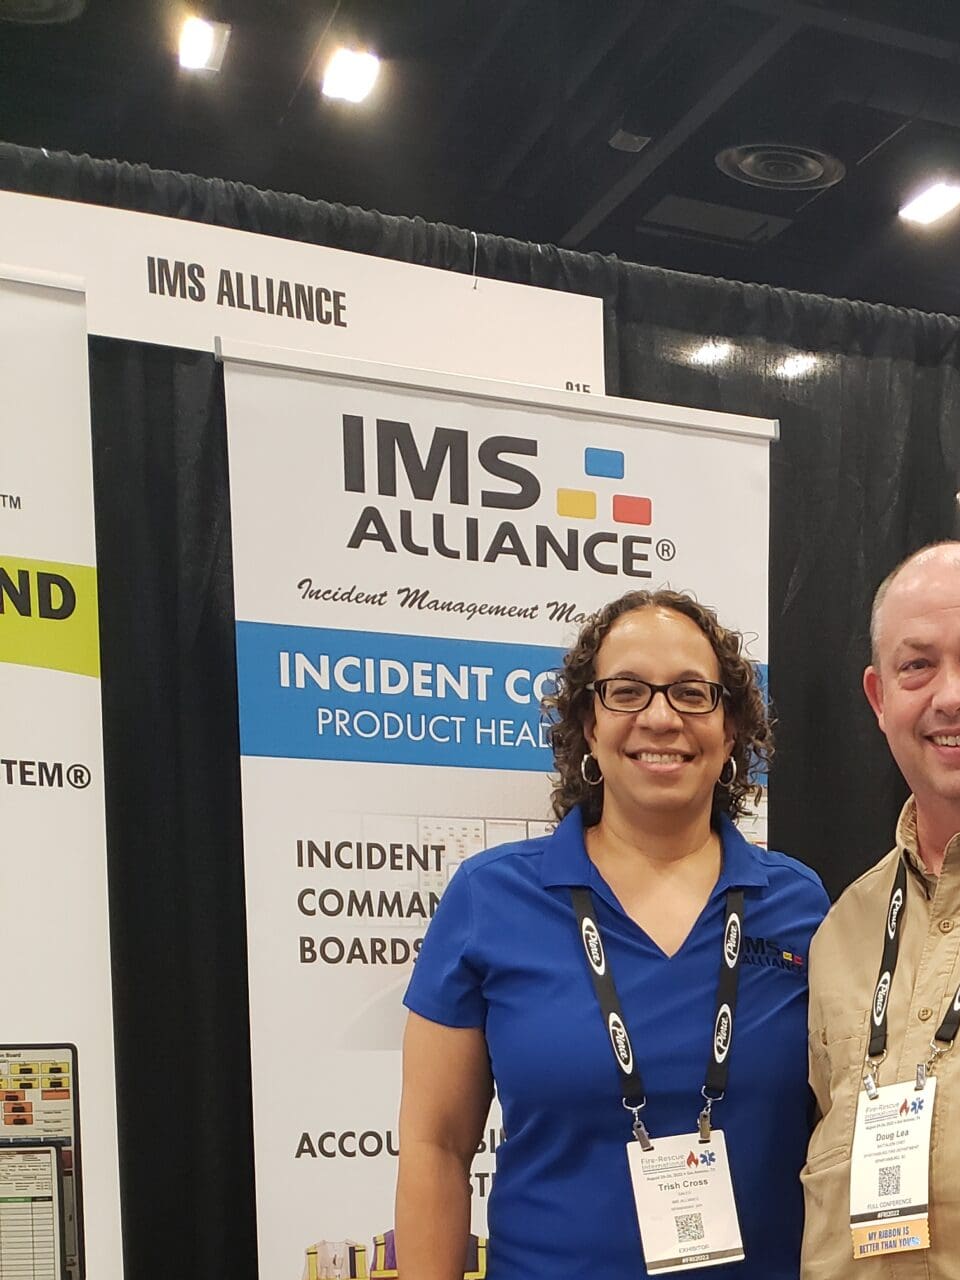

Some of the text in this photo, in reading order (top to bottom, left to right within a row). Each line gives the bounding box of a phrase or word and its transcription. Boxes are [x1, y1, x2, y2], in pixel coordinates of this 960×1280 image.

[146, 255, 347, 328] IMS ALLIANCE
[341, 413, 542, 512] IMS
[297, 577, 388, 607] Incident
[396, 587, 539, 621] Management
[279, 651, 493, 701] INCIDENT
[317, 707, 466, 744] PRODUCT
[295, 838, 446, 872] INCIDENT
[876, 1129, 909, 1142] Doug Lea
[657, 1179, 709, 1192] Trish Cross
[883, 1197, 912, 1209] CONFERENCE
[868, 1225, 910, 1241] MY RIBBON IS
[881, 1239, 897, 1250] THAN
